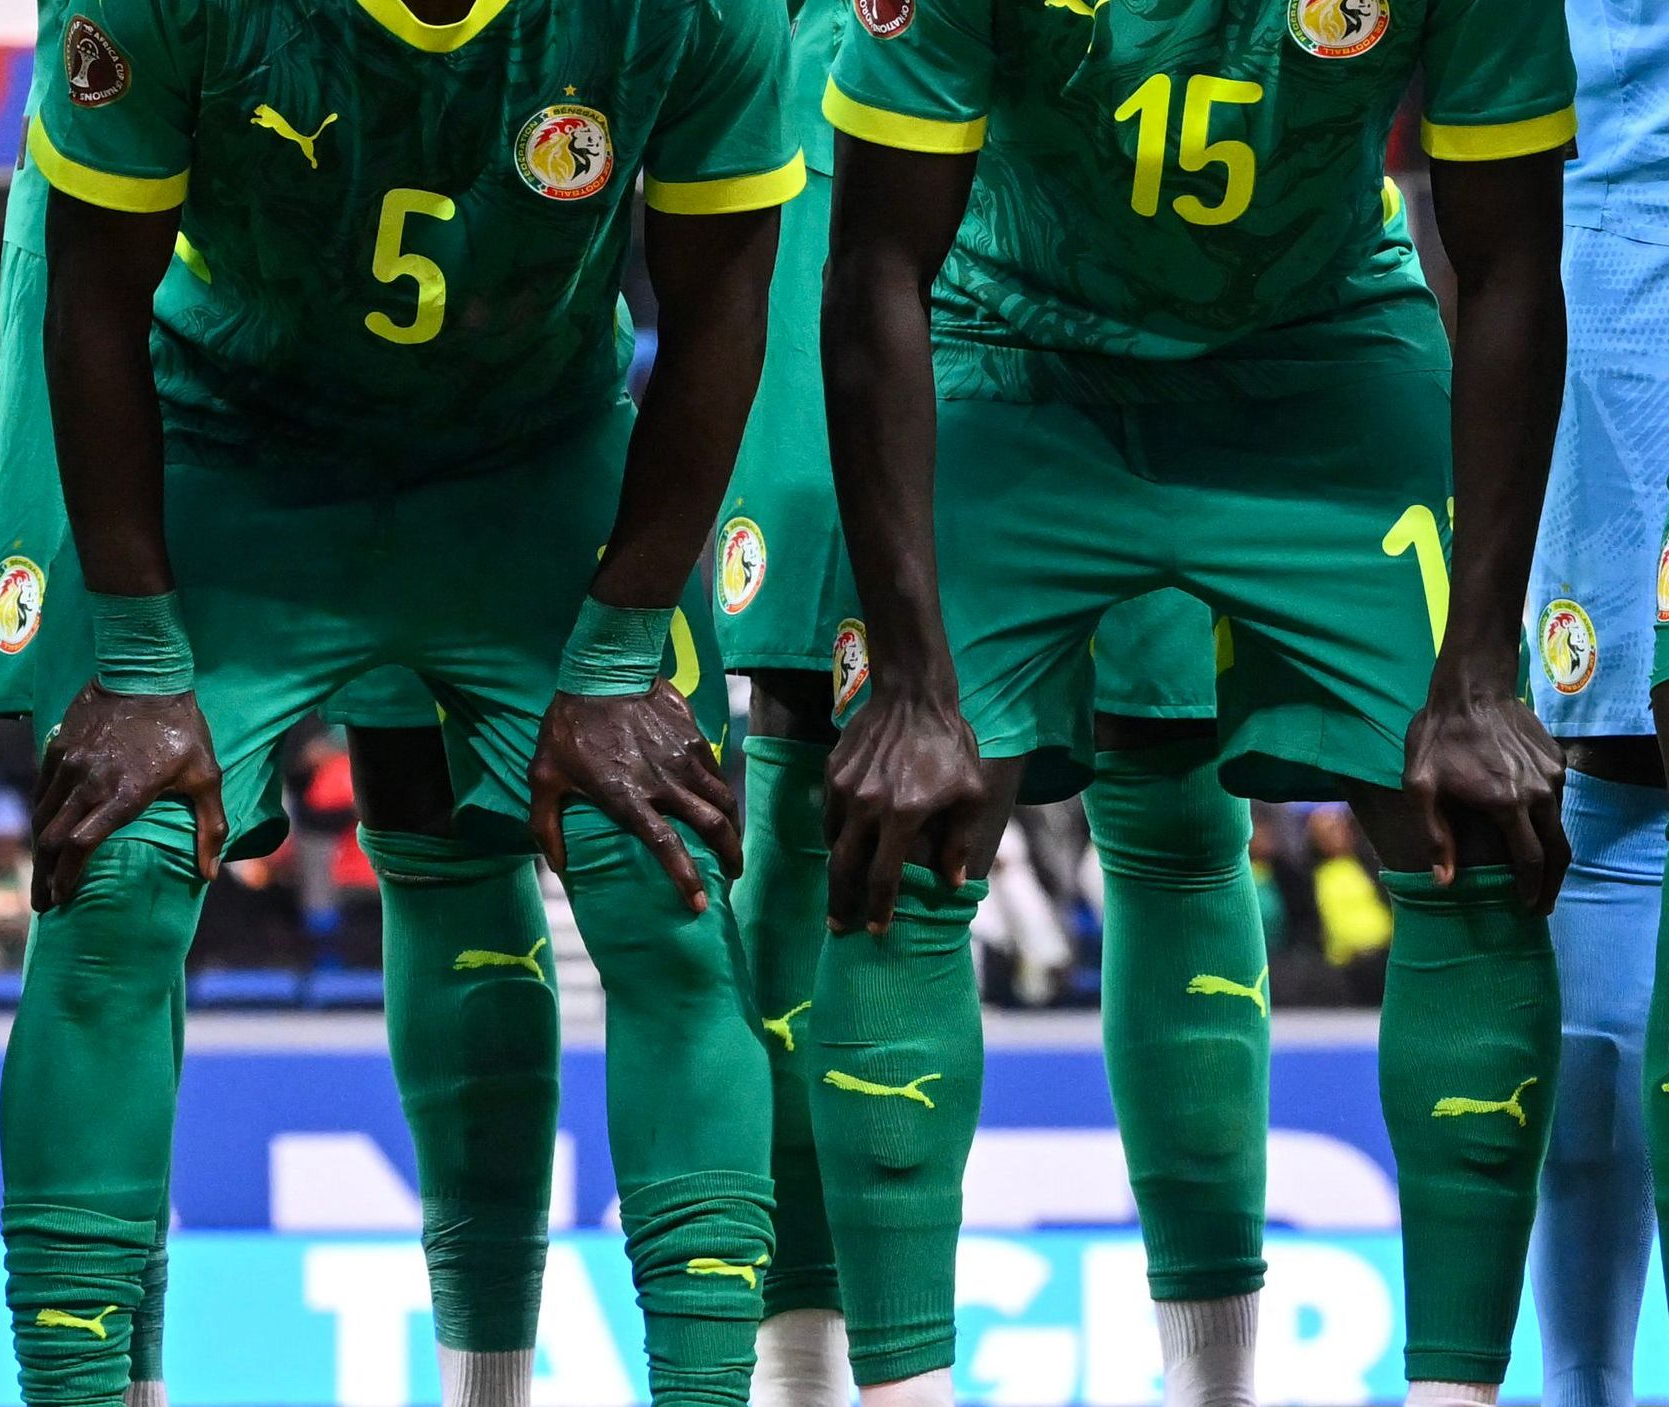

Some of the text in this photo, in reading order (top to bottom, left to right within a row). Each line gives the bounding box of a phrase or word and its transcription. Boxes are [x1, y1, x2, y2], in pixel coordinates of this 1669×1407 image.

[1114, 73, 1263, 226] 15
[363, 187, 457, 344] 5
[1382, 496, 1454, 658] 1
[304, 1242, 1395, 1405] TAGER
